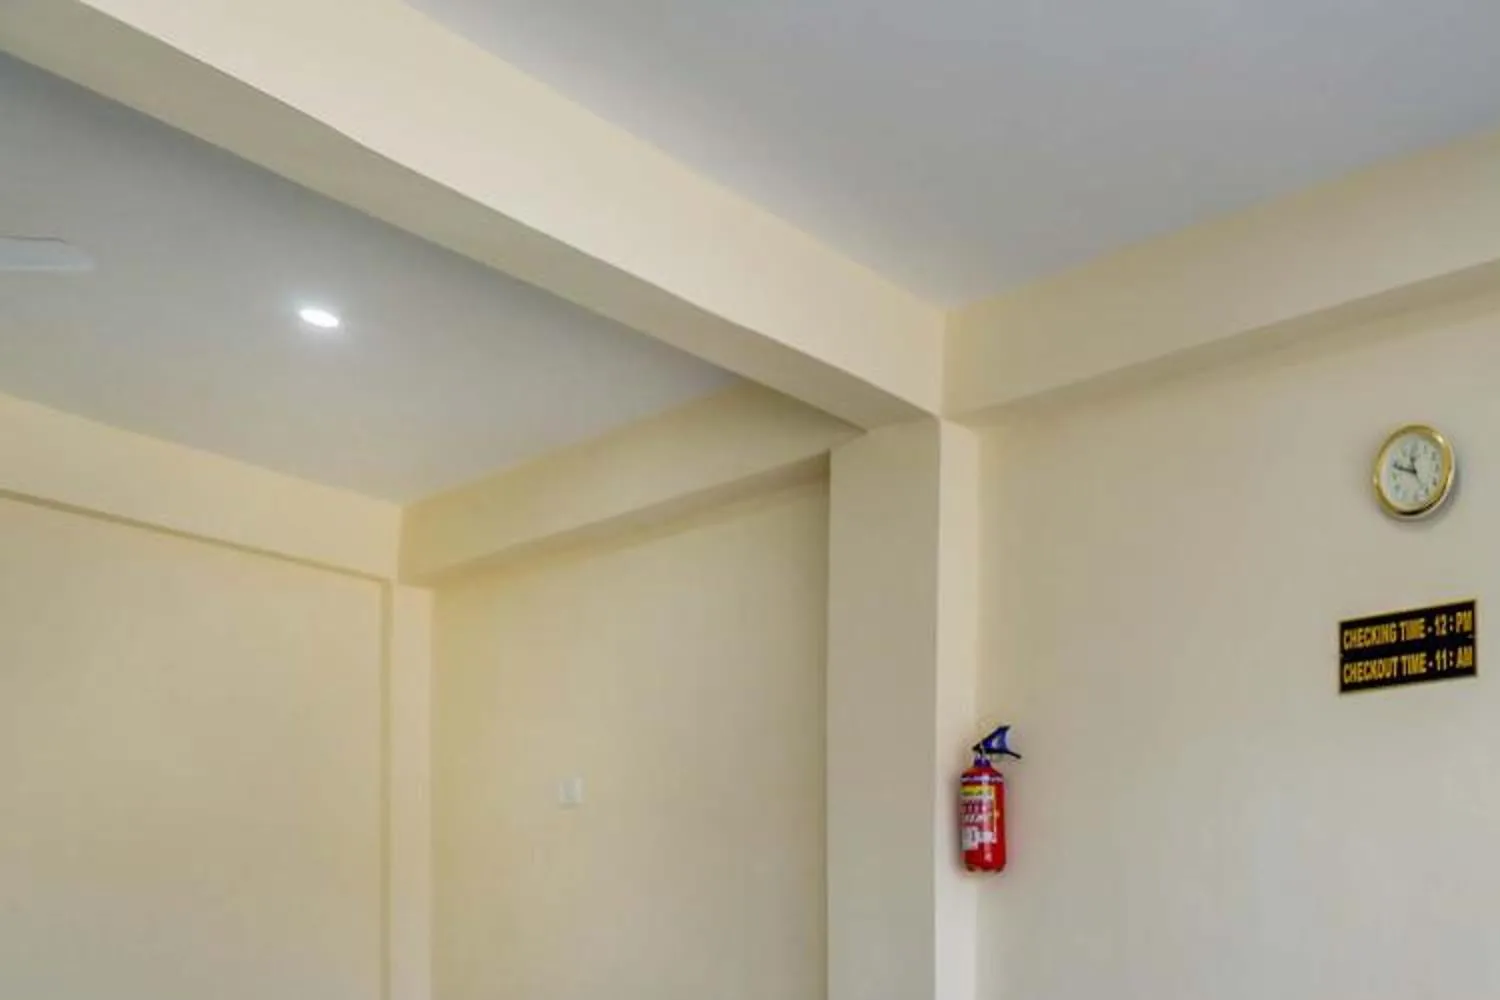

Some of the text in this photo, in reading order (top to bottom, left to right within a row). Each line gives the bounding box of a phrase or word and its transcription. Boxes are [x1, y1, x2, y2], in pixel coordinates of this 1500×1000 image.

[1343, 623, 1397, 650] CHECKING
[1400, 618, 1426, 641] TIME
[1343, 656, 1399, 684] CHECKOUT
[1401, 652, 1427, 676] TIME
